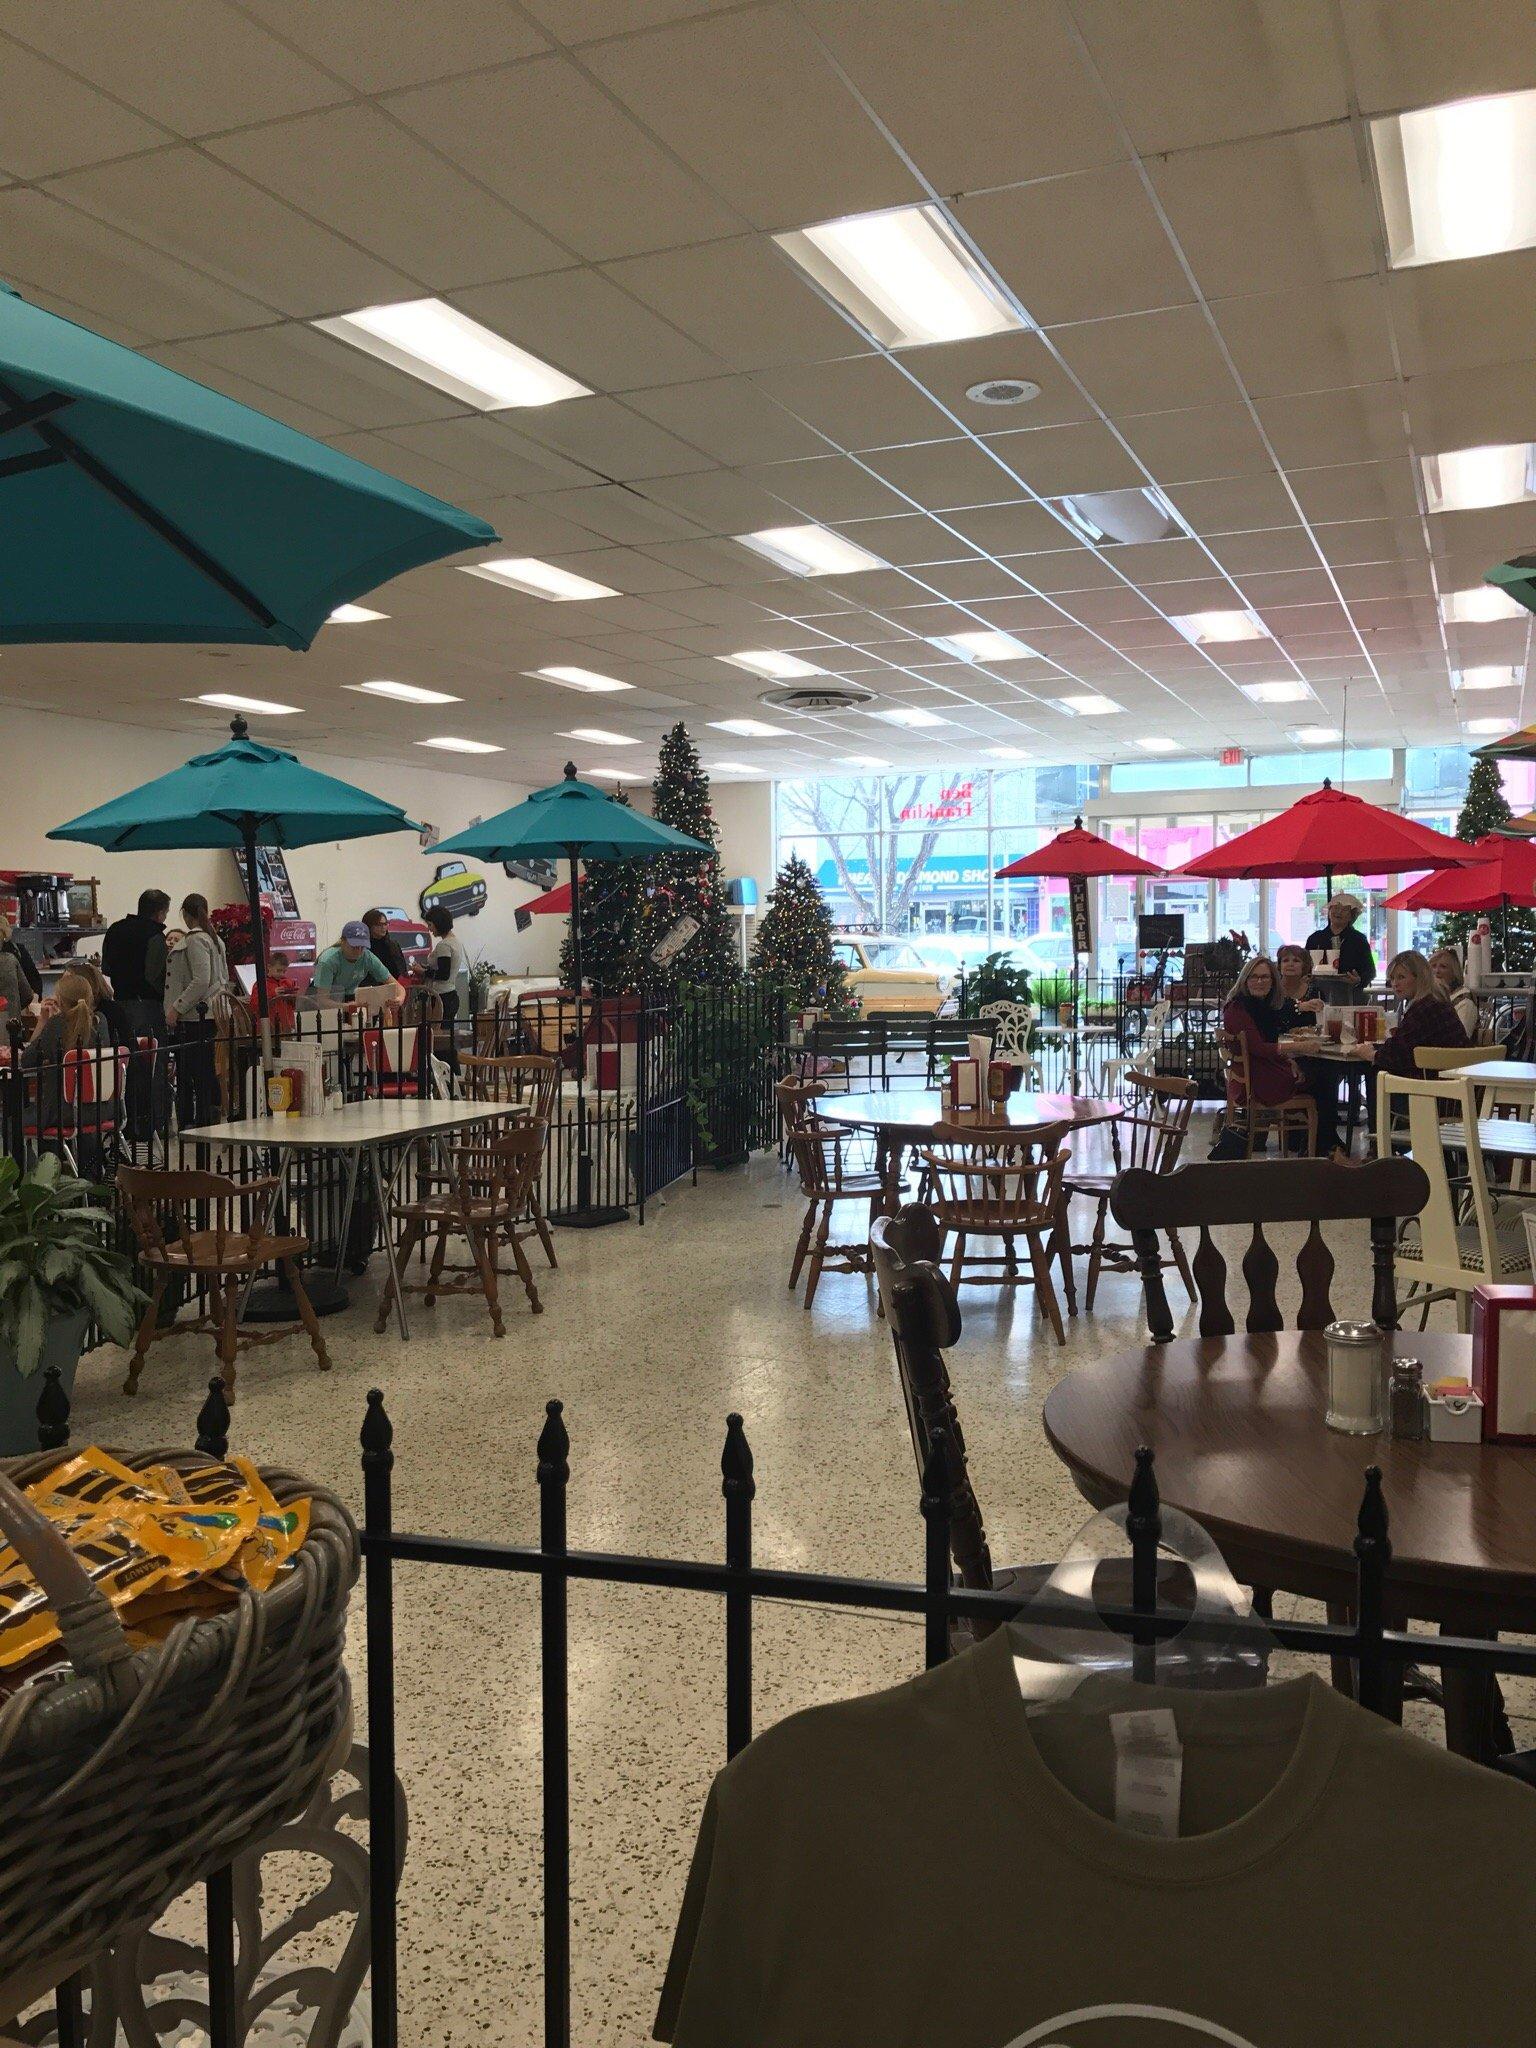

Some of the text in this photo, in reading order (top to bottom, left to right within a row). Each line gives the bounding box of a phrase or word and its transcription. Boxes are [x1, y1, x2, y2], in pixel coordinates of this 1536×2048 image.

[1223, 749, 1242, 764] EXIT
[896, 870, 959, 884] DIMOND
[1073, 884, 1088, 950] THEATER
[124, 1560, 161, 1581] PEANUT
